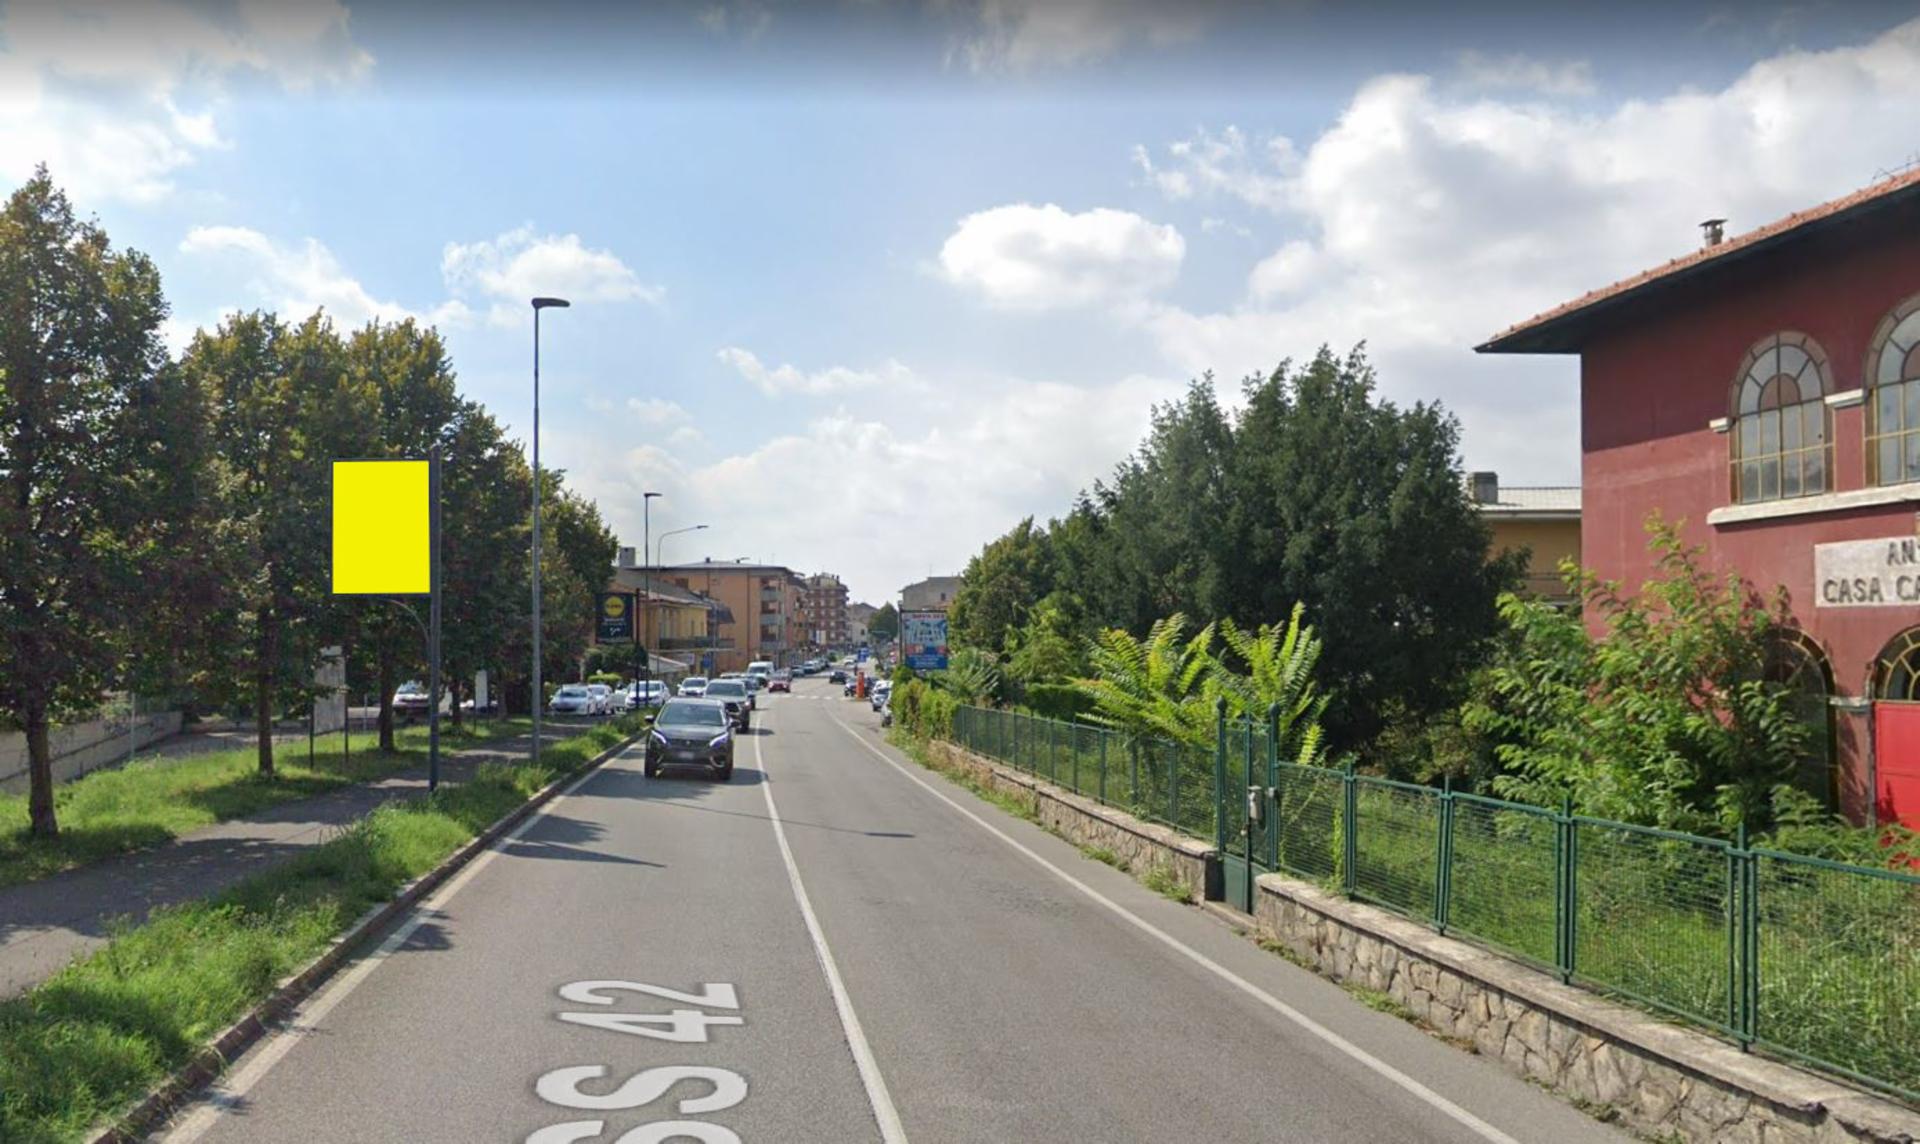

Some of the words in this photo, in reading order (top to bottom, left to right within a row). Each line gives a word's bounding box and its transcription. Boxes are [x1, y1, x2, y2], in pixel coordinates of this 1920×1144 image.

[1886, 539, 1920, 566] AN
[1823, 577, 1883, 603] CASA
[557, 980, 745, 1042] 42
